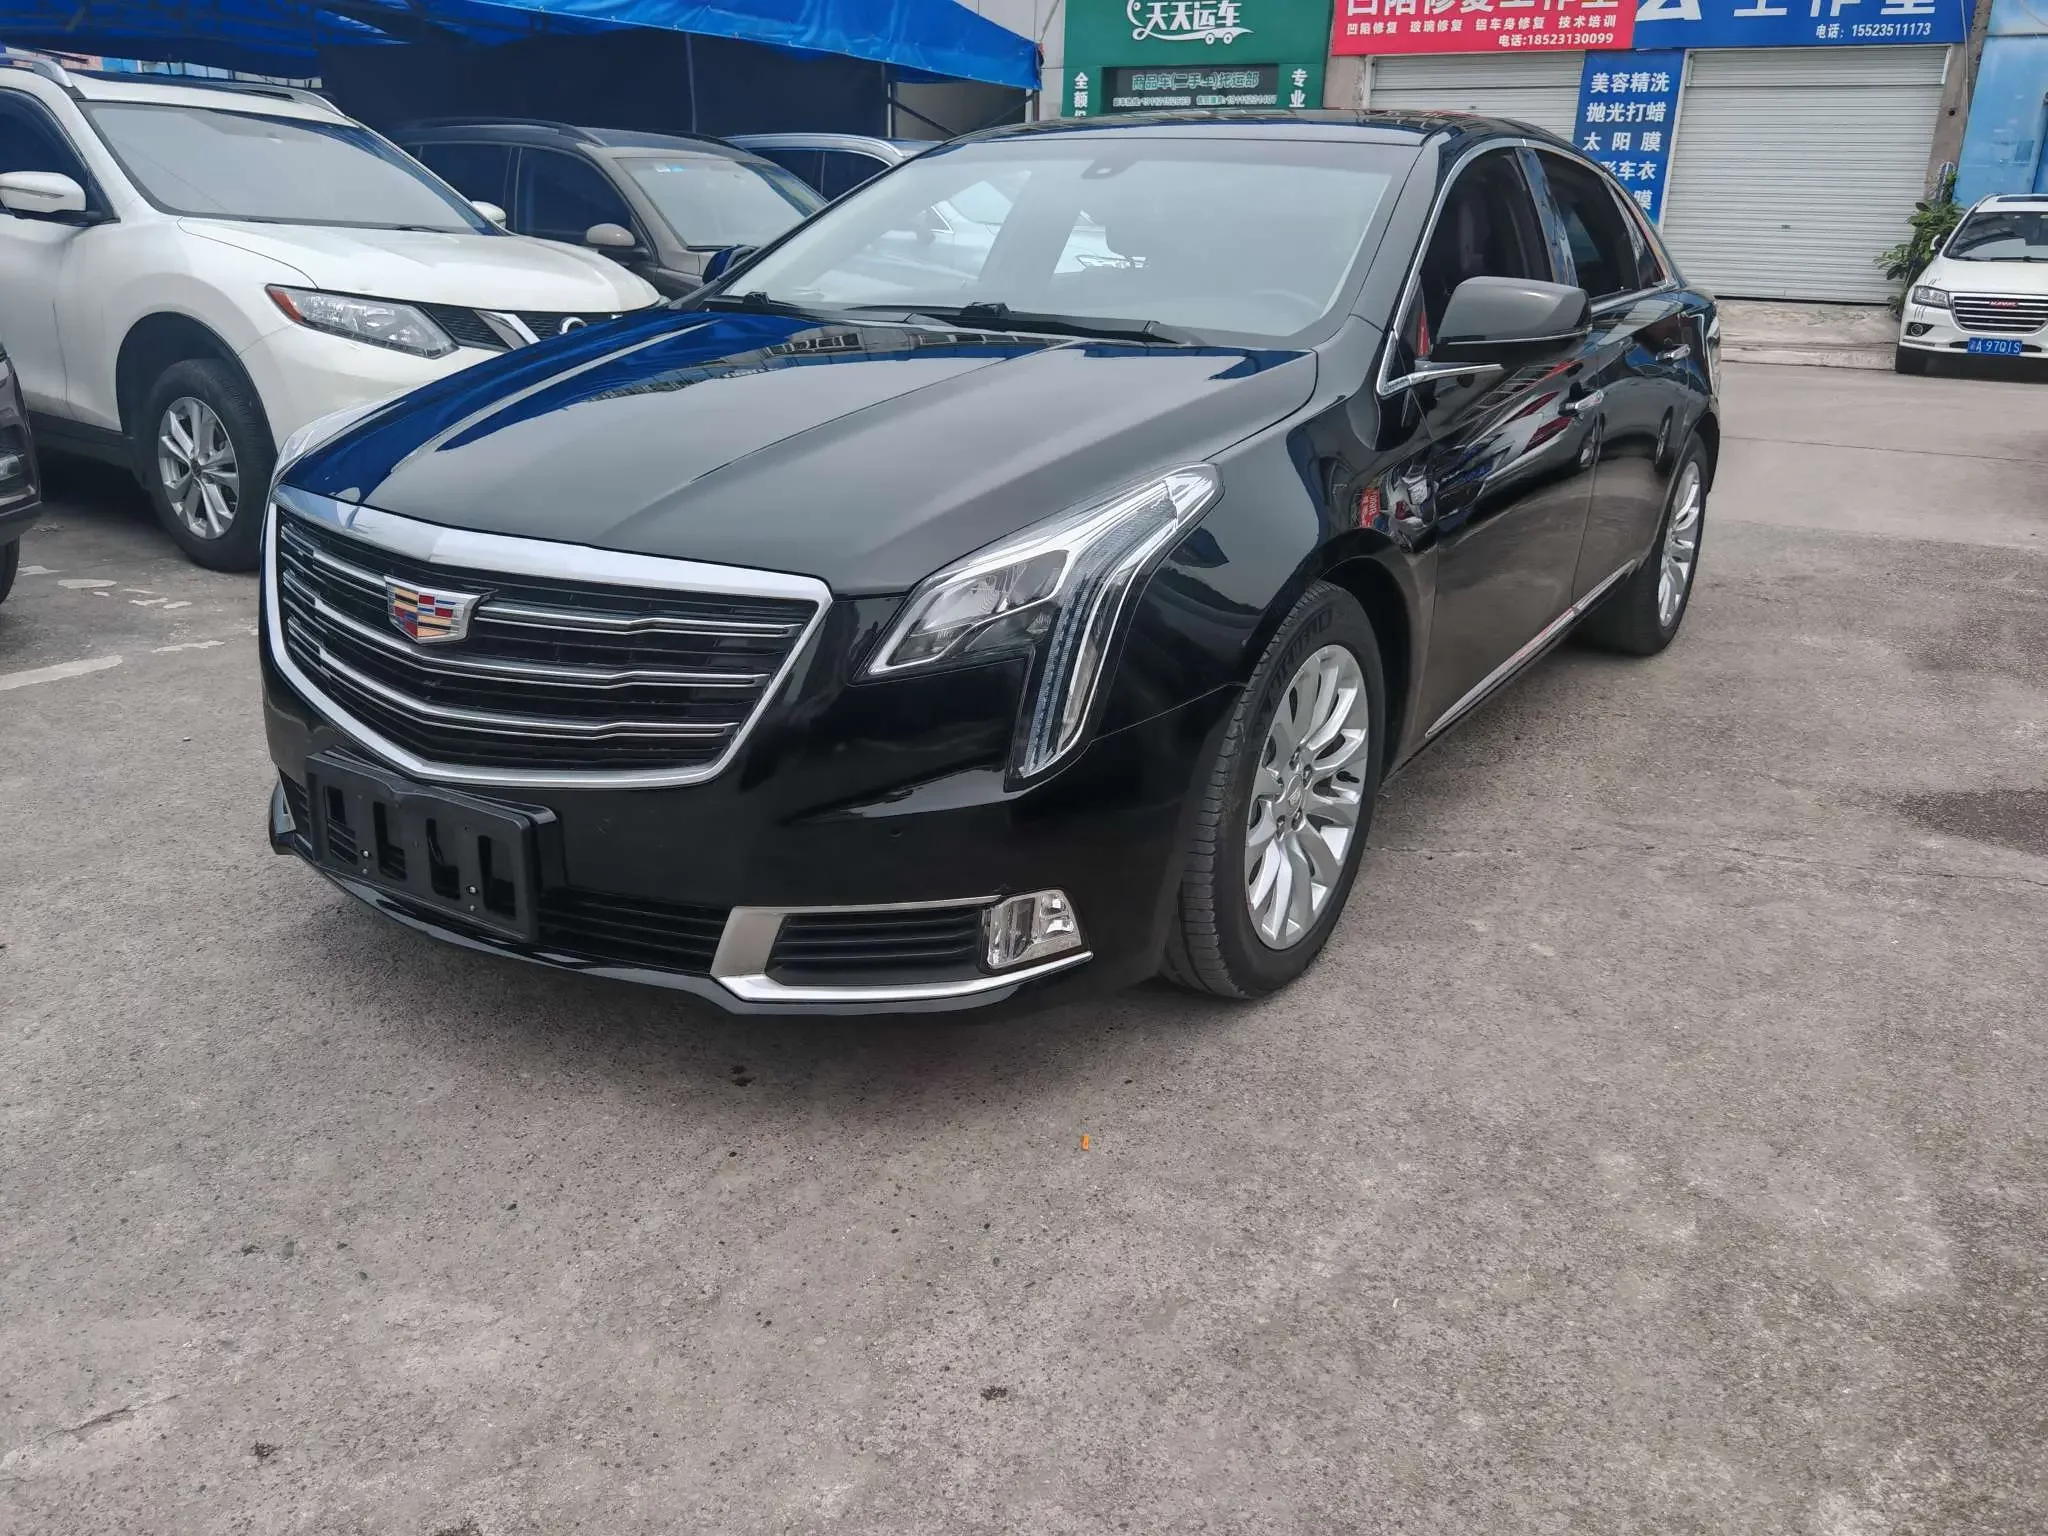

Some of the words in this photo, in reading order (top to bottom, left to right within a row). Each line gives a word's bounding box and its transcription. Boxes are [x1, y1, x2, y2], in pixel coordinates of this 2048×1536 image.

[1145, 0, 1242, 31] 天天运车
[1557, 14, 1617, 29] 技术培训
[1289, 68, 1308, 108] 专业
[1590, 71, 1670, 93] 美容精洗
[1586, 102, 1667, 123] 抛光打蜡
